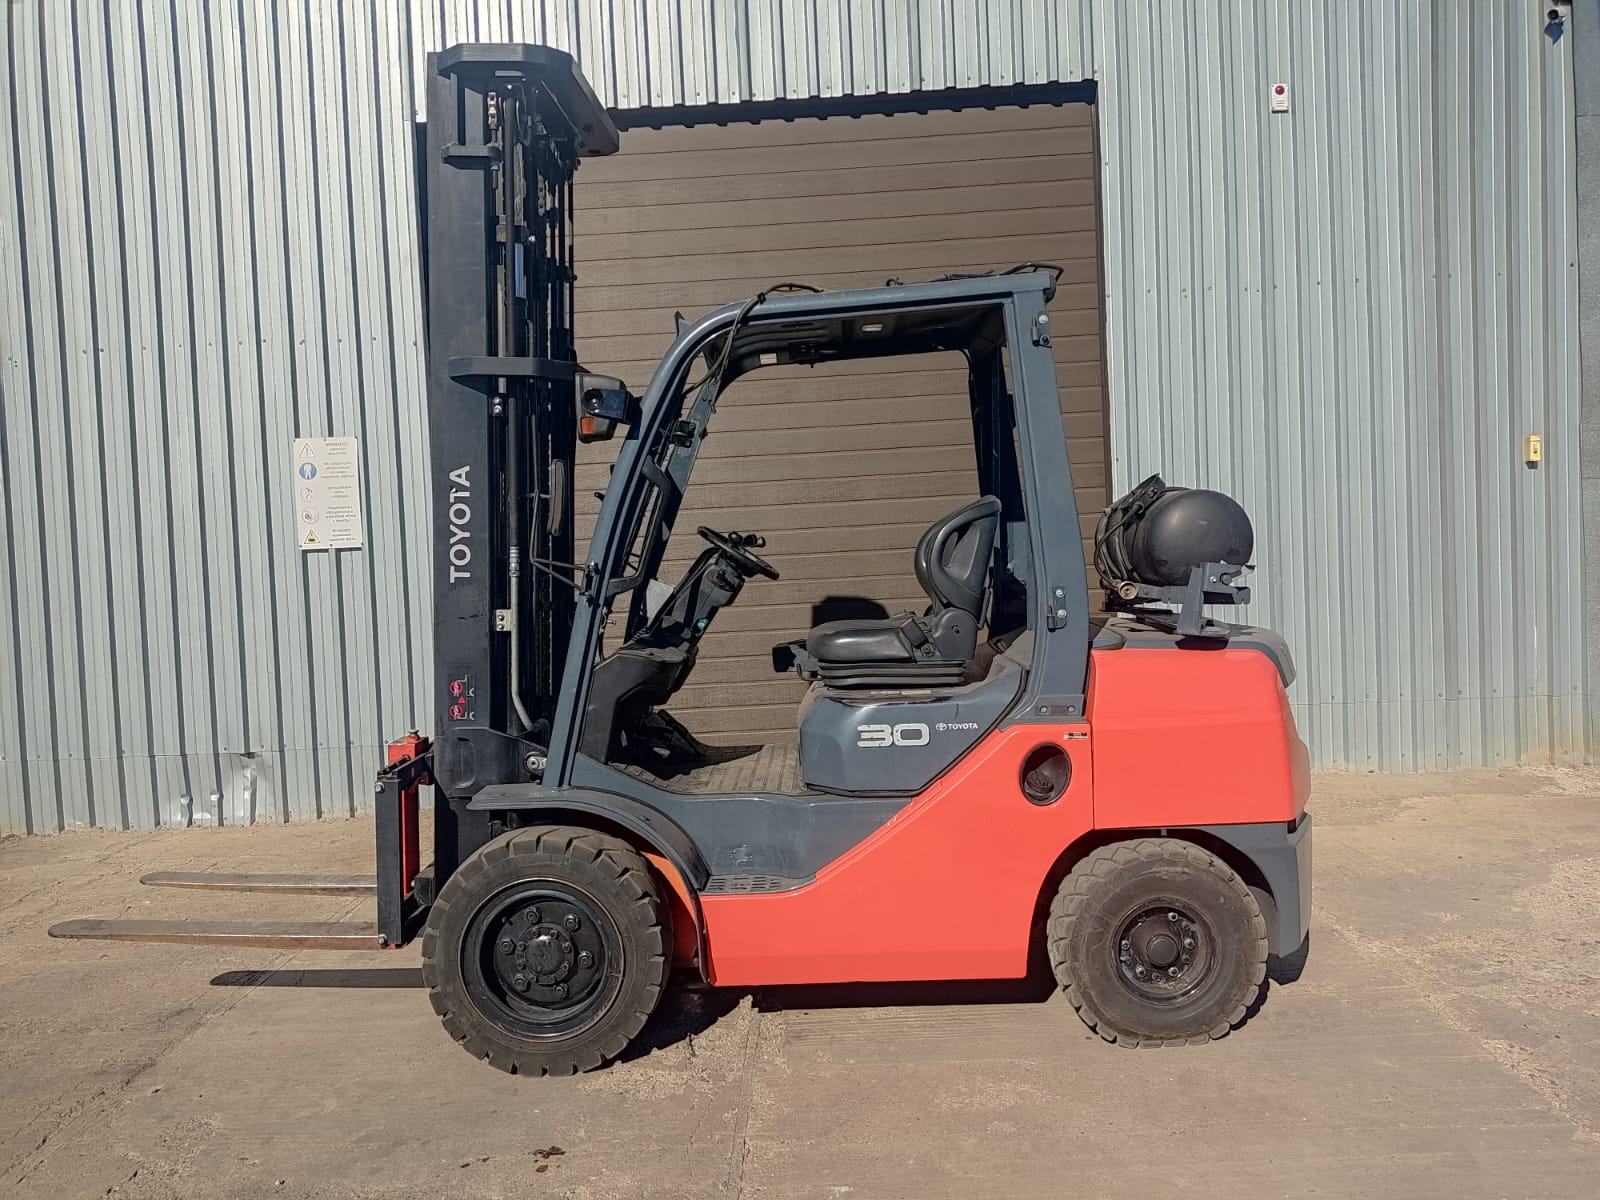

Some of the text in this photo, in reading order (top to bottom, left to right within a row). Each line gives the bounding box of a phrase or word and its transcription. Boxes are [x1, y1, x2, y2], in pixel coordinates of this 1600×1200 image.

[449, 465, 471, 583] TOYOTA
[857, 723, 930, 748] 30
[947, 722, 979, 731] TOYOTA
